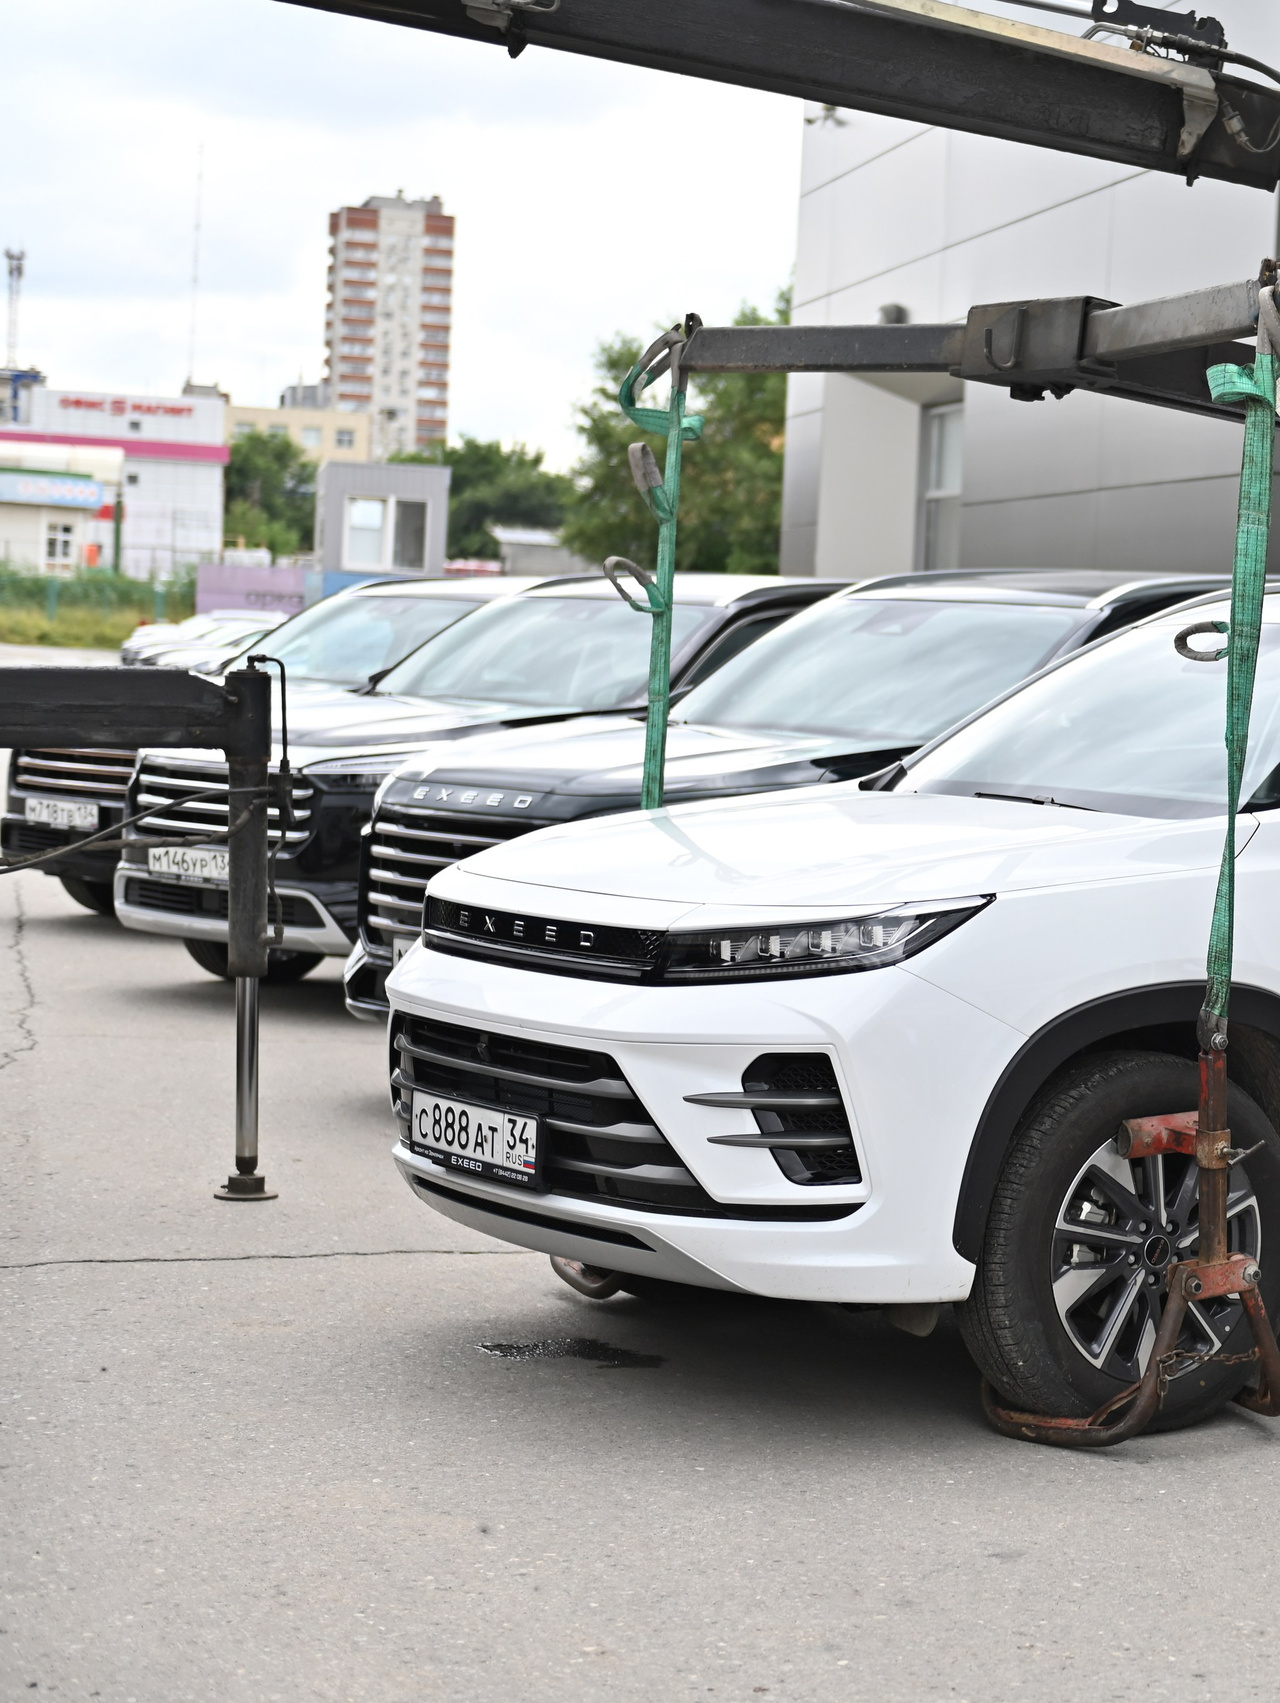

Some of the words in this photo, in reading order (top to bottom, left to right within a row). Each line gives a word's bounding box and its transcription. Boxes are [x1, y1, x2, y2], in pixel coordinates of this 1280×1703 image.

[413, 786, 533, 809] EXEED
[153, 850, 207, 872] М146УР
[212, 854, 229, 871] 13
[459, 910, 594, 947] EXEED
[506, 1118, 530, 1154] 34
[451, 1155, 482, 1171] EXEED
[505, 1151, 523, 1166] RUS
